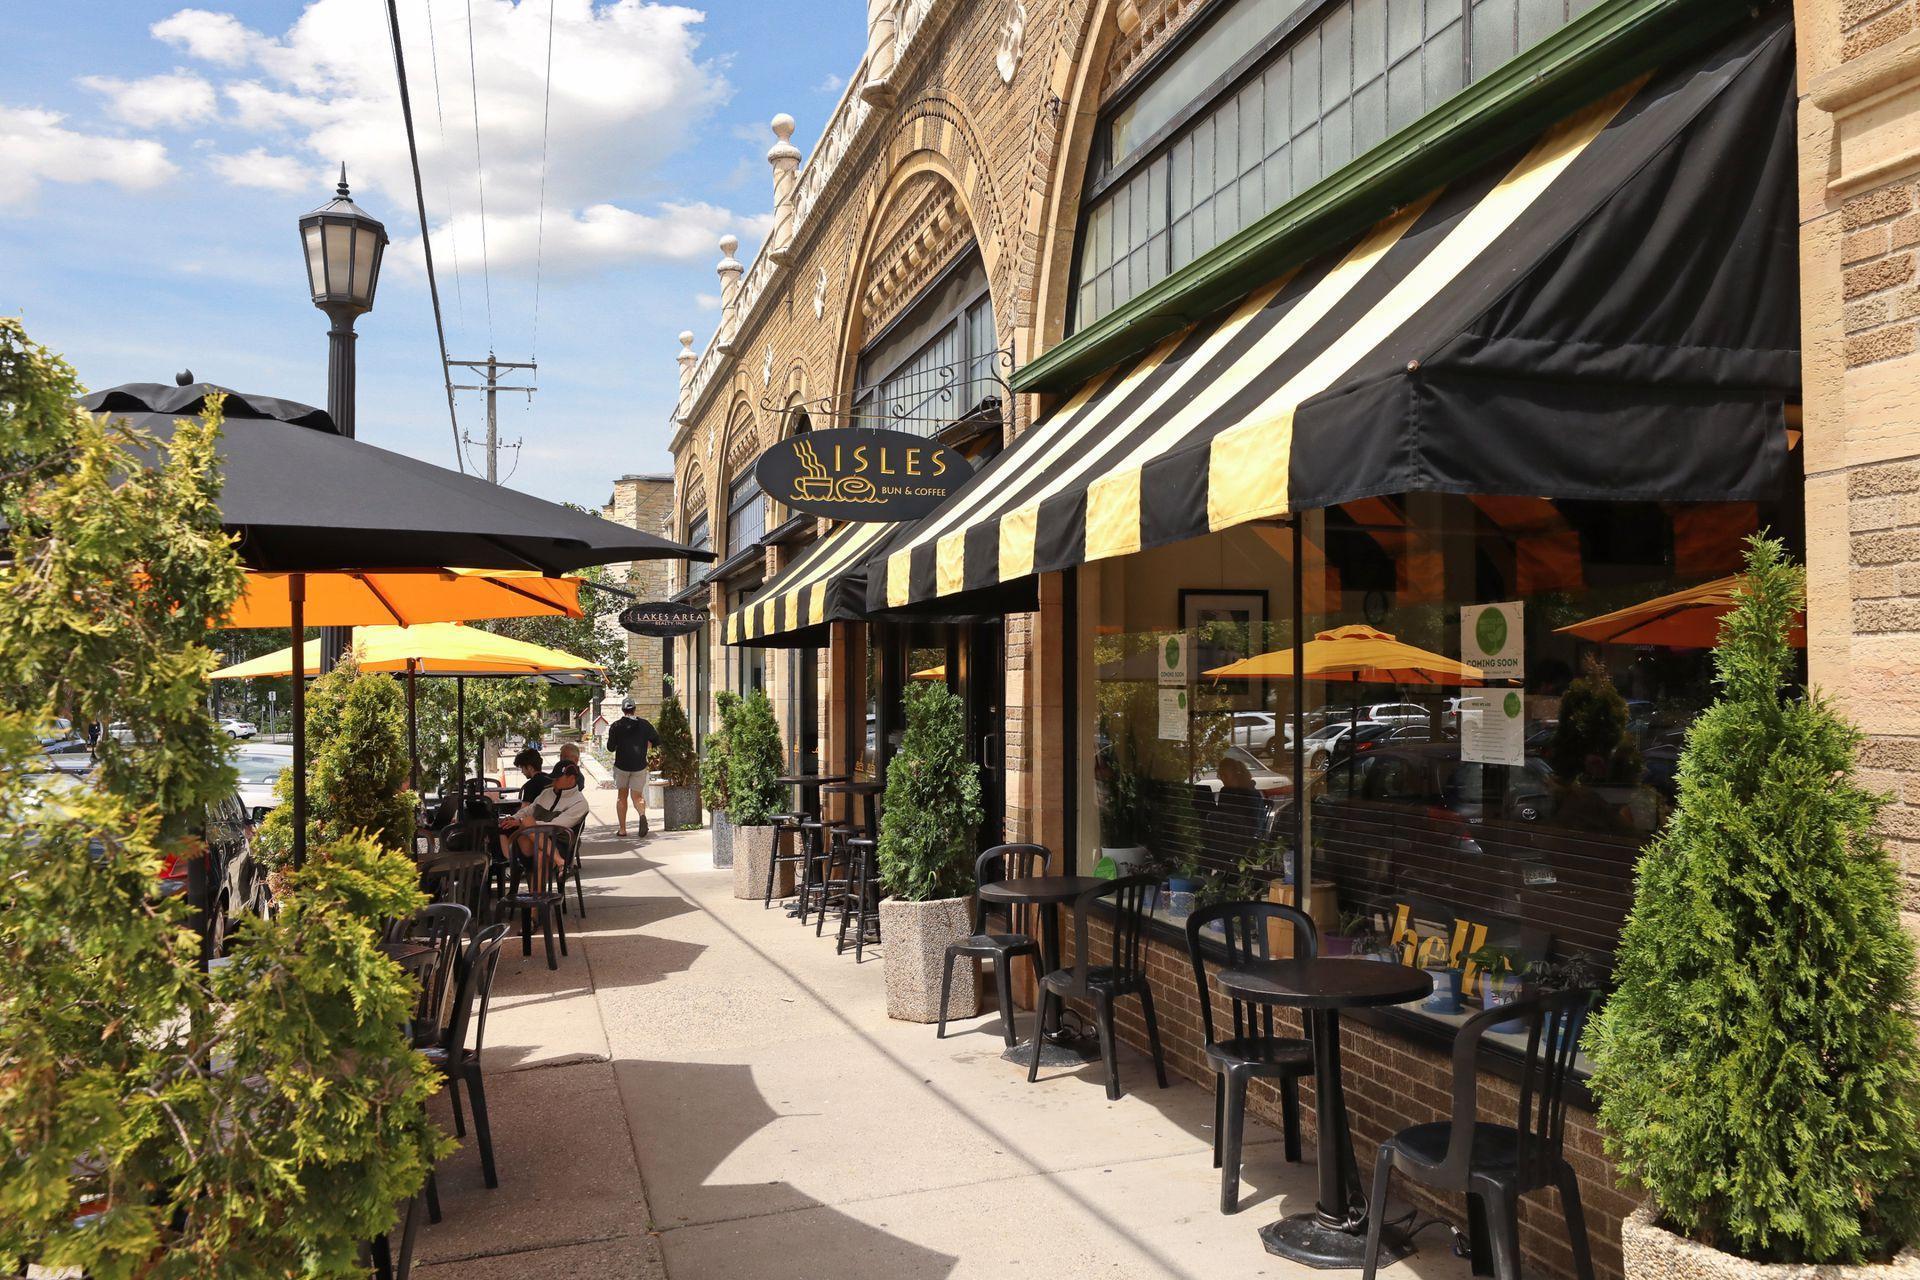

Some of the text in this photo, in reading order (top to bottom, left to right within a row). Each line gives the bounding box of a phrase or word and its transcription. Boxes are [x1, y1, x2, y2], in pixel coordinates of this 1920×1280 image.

[834, 444, 947, 477] ISLES
[881, 486, 946, 497] BUN & COFFEE
[637, 613, 704, 621] LAKES AREA
[1466, 658, 1518, 667] COMING SOON
[1391, 903, 1513, 997] hell
